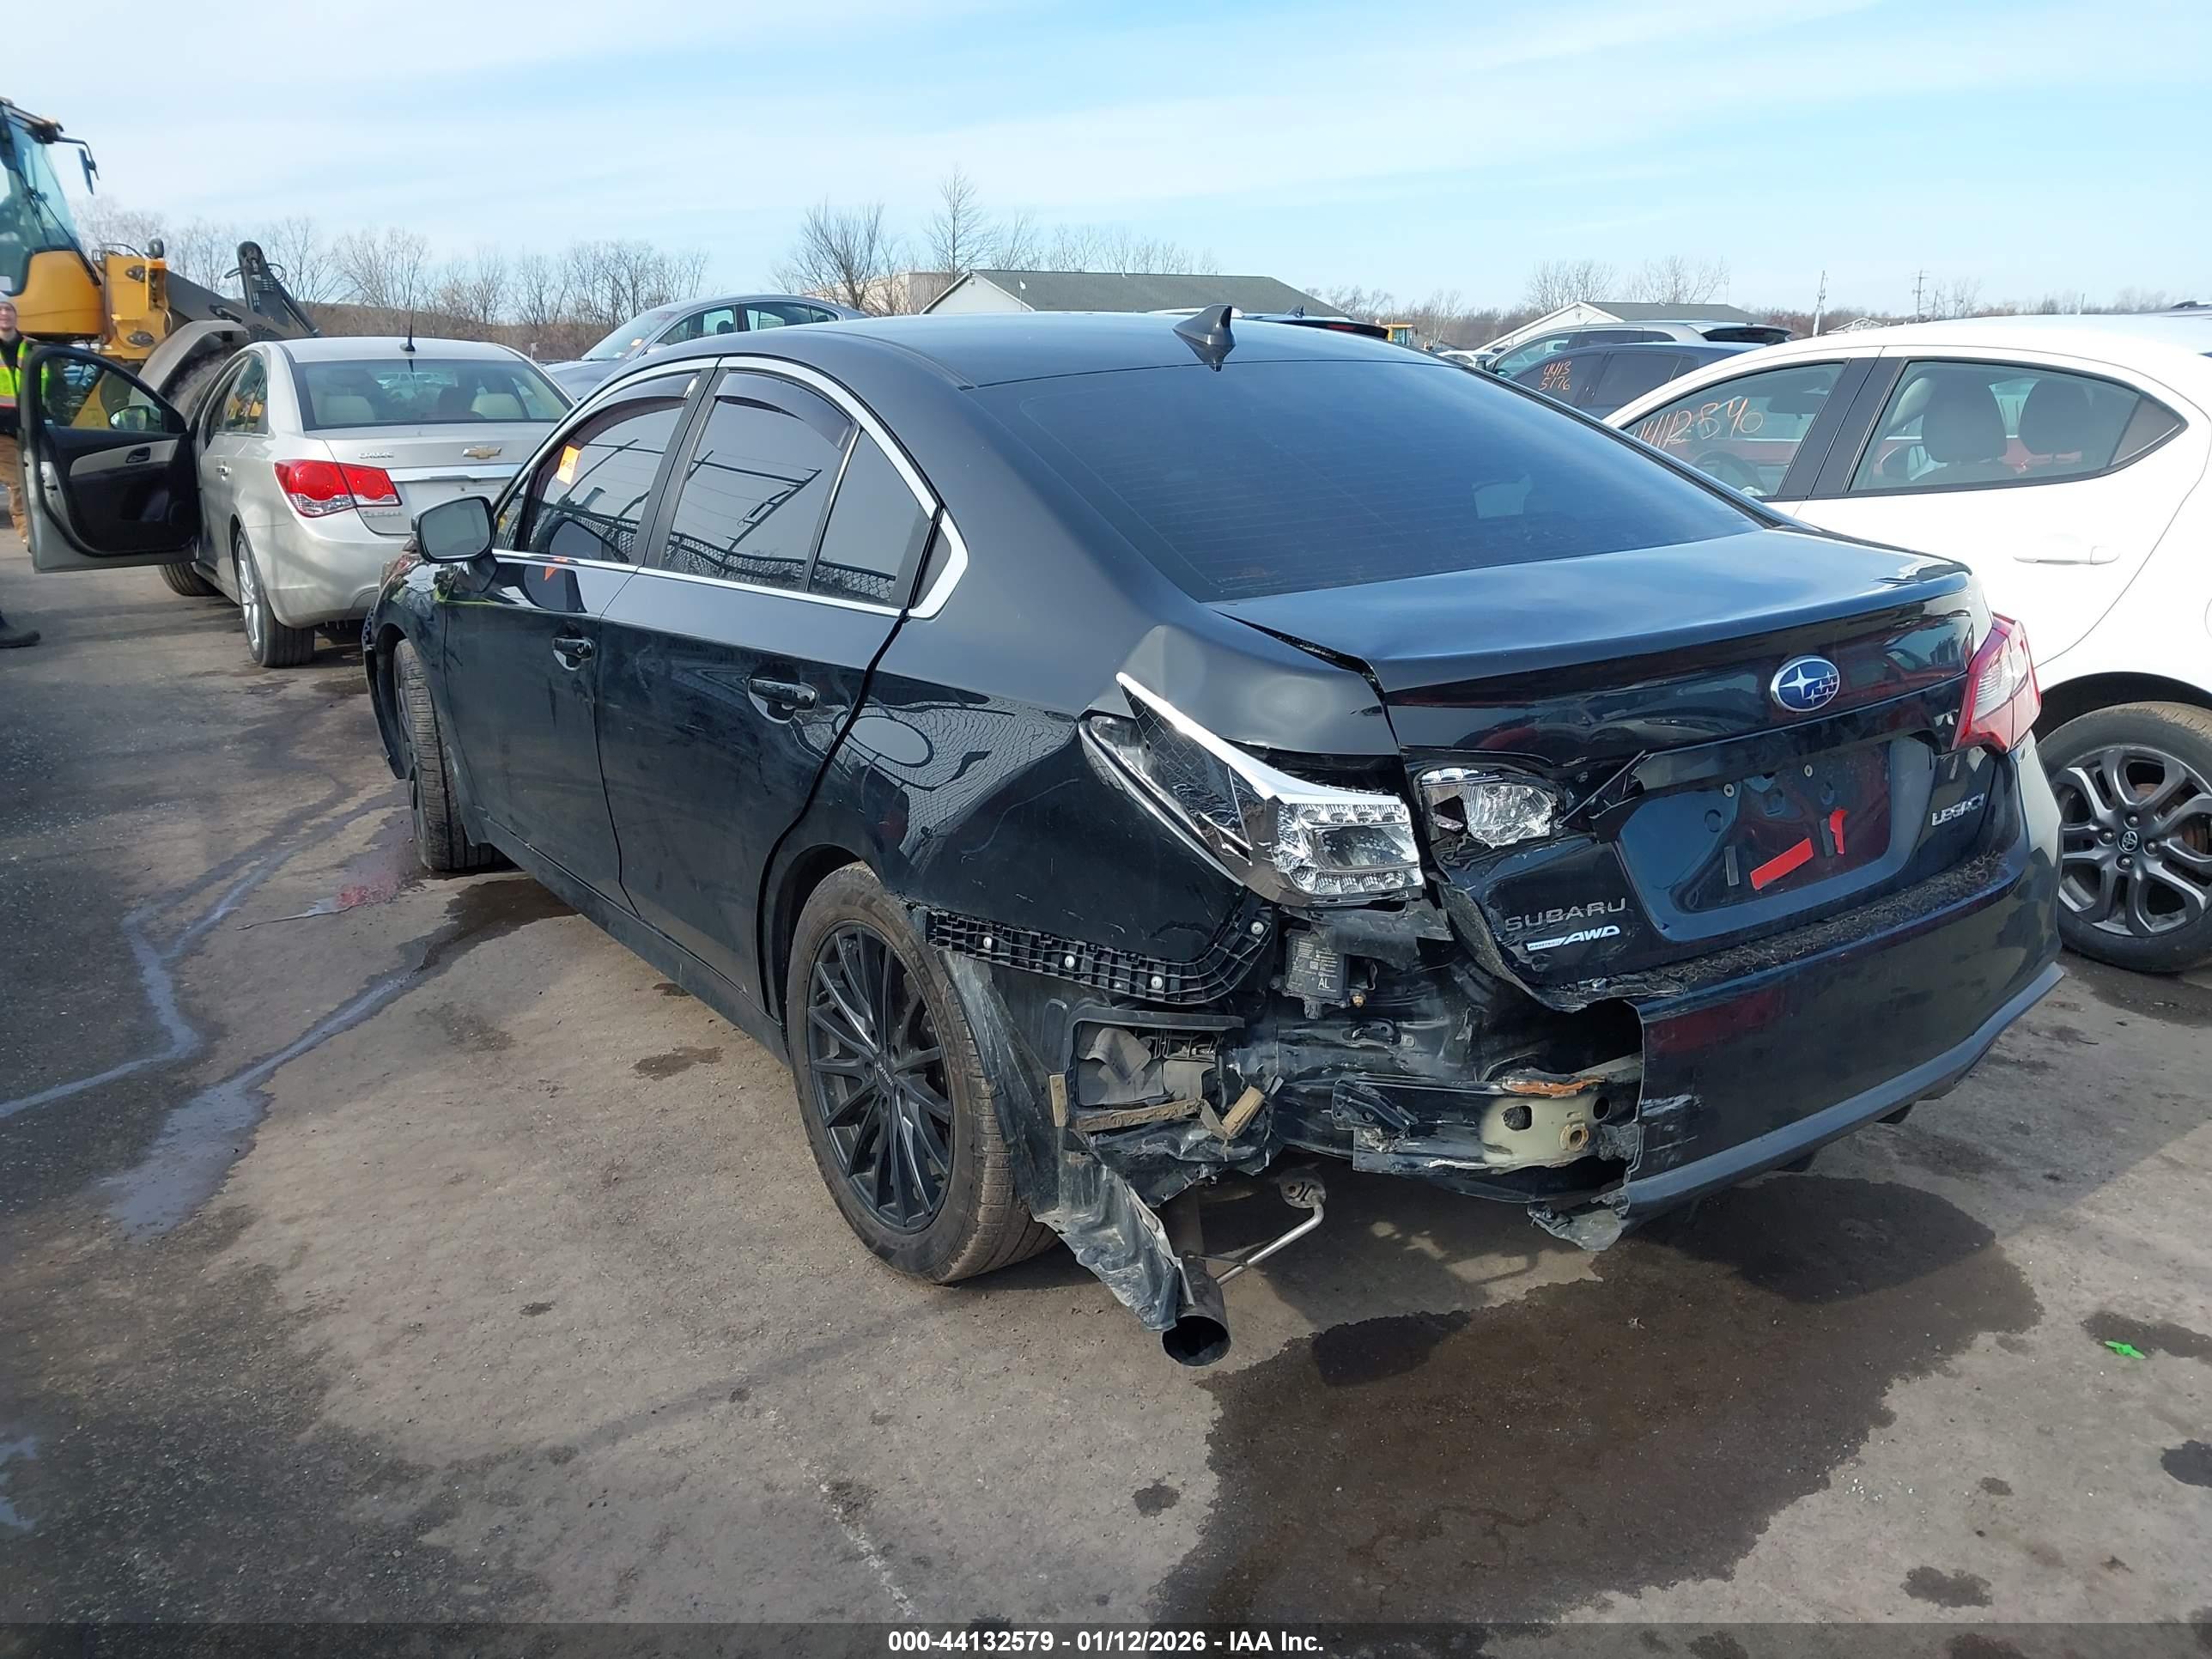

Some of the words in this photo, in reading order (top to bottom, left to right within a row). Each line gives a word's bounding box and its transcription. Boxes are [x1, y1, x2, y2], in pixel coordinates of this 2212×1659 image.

[1543, 361, 1572, 377] 4413
[1538, 376, 1571, 392] 5176
[1504, 897, 1626, 933] SUBARU
[1563, 926, 1621, 945] AWD
